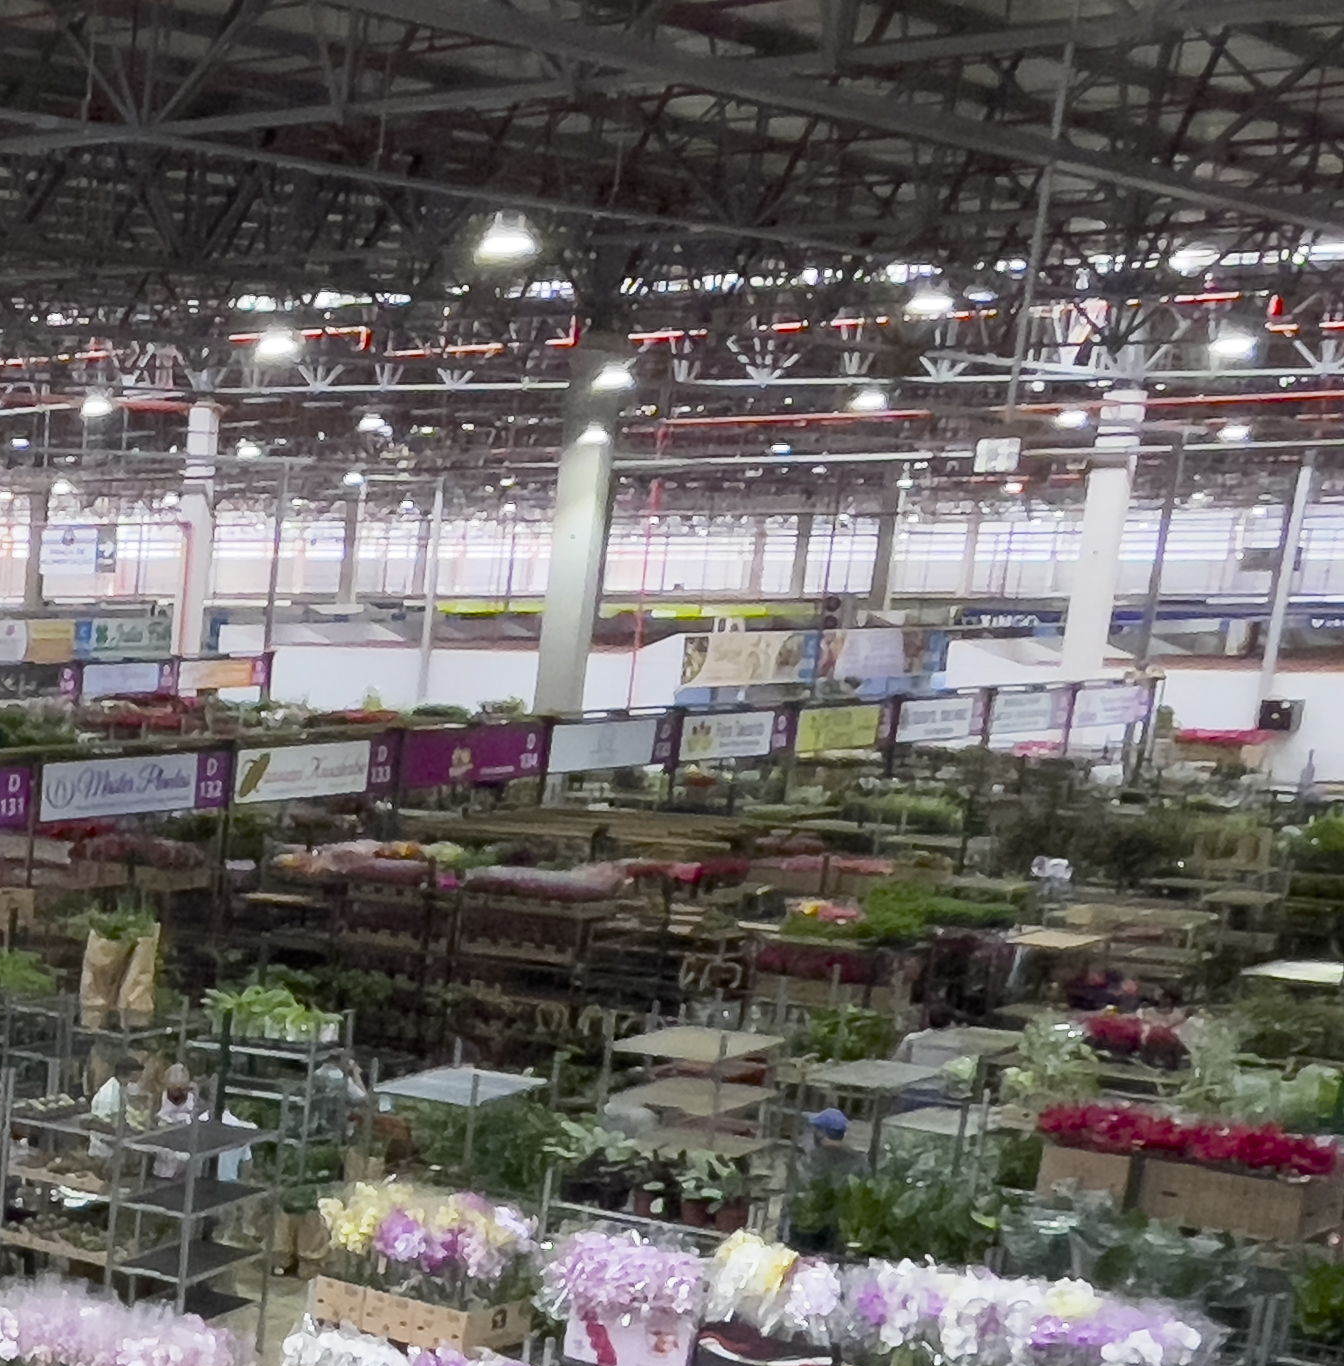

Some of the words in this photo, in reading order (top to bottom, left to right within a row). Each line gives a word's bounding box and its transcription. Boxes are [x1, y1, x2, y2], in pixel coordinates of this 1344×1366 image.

[377, 745, 388, 763] D
[206, 758, 219, 776] D
[371, 765, 391, 784] 133
[7, 774, 21, 793] D
[199, 780, 223, 799] 132
[0, 797, 25, 817] 131
